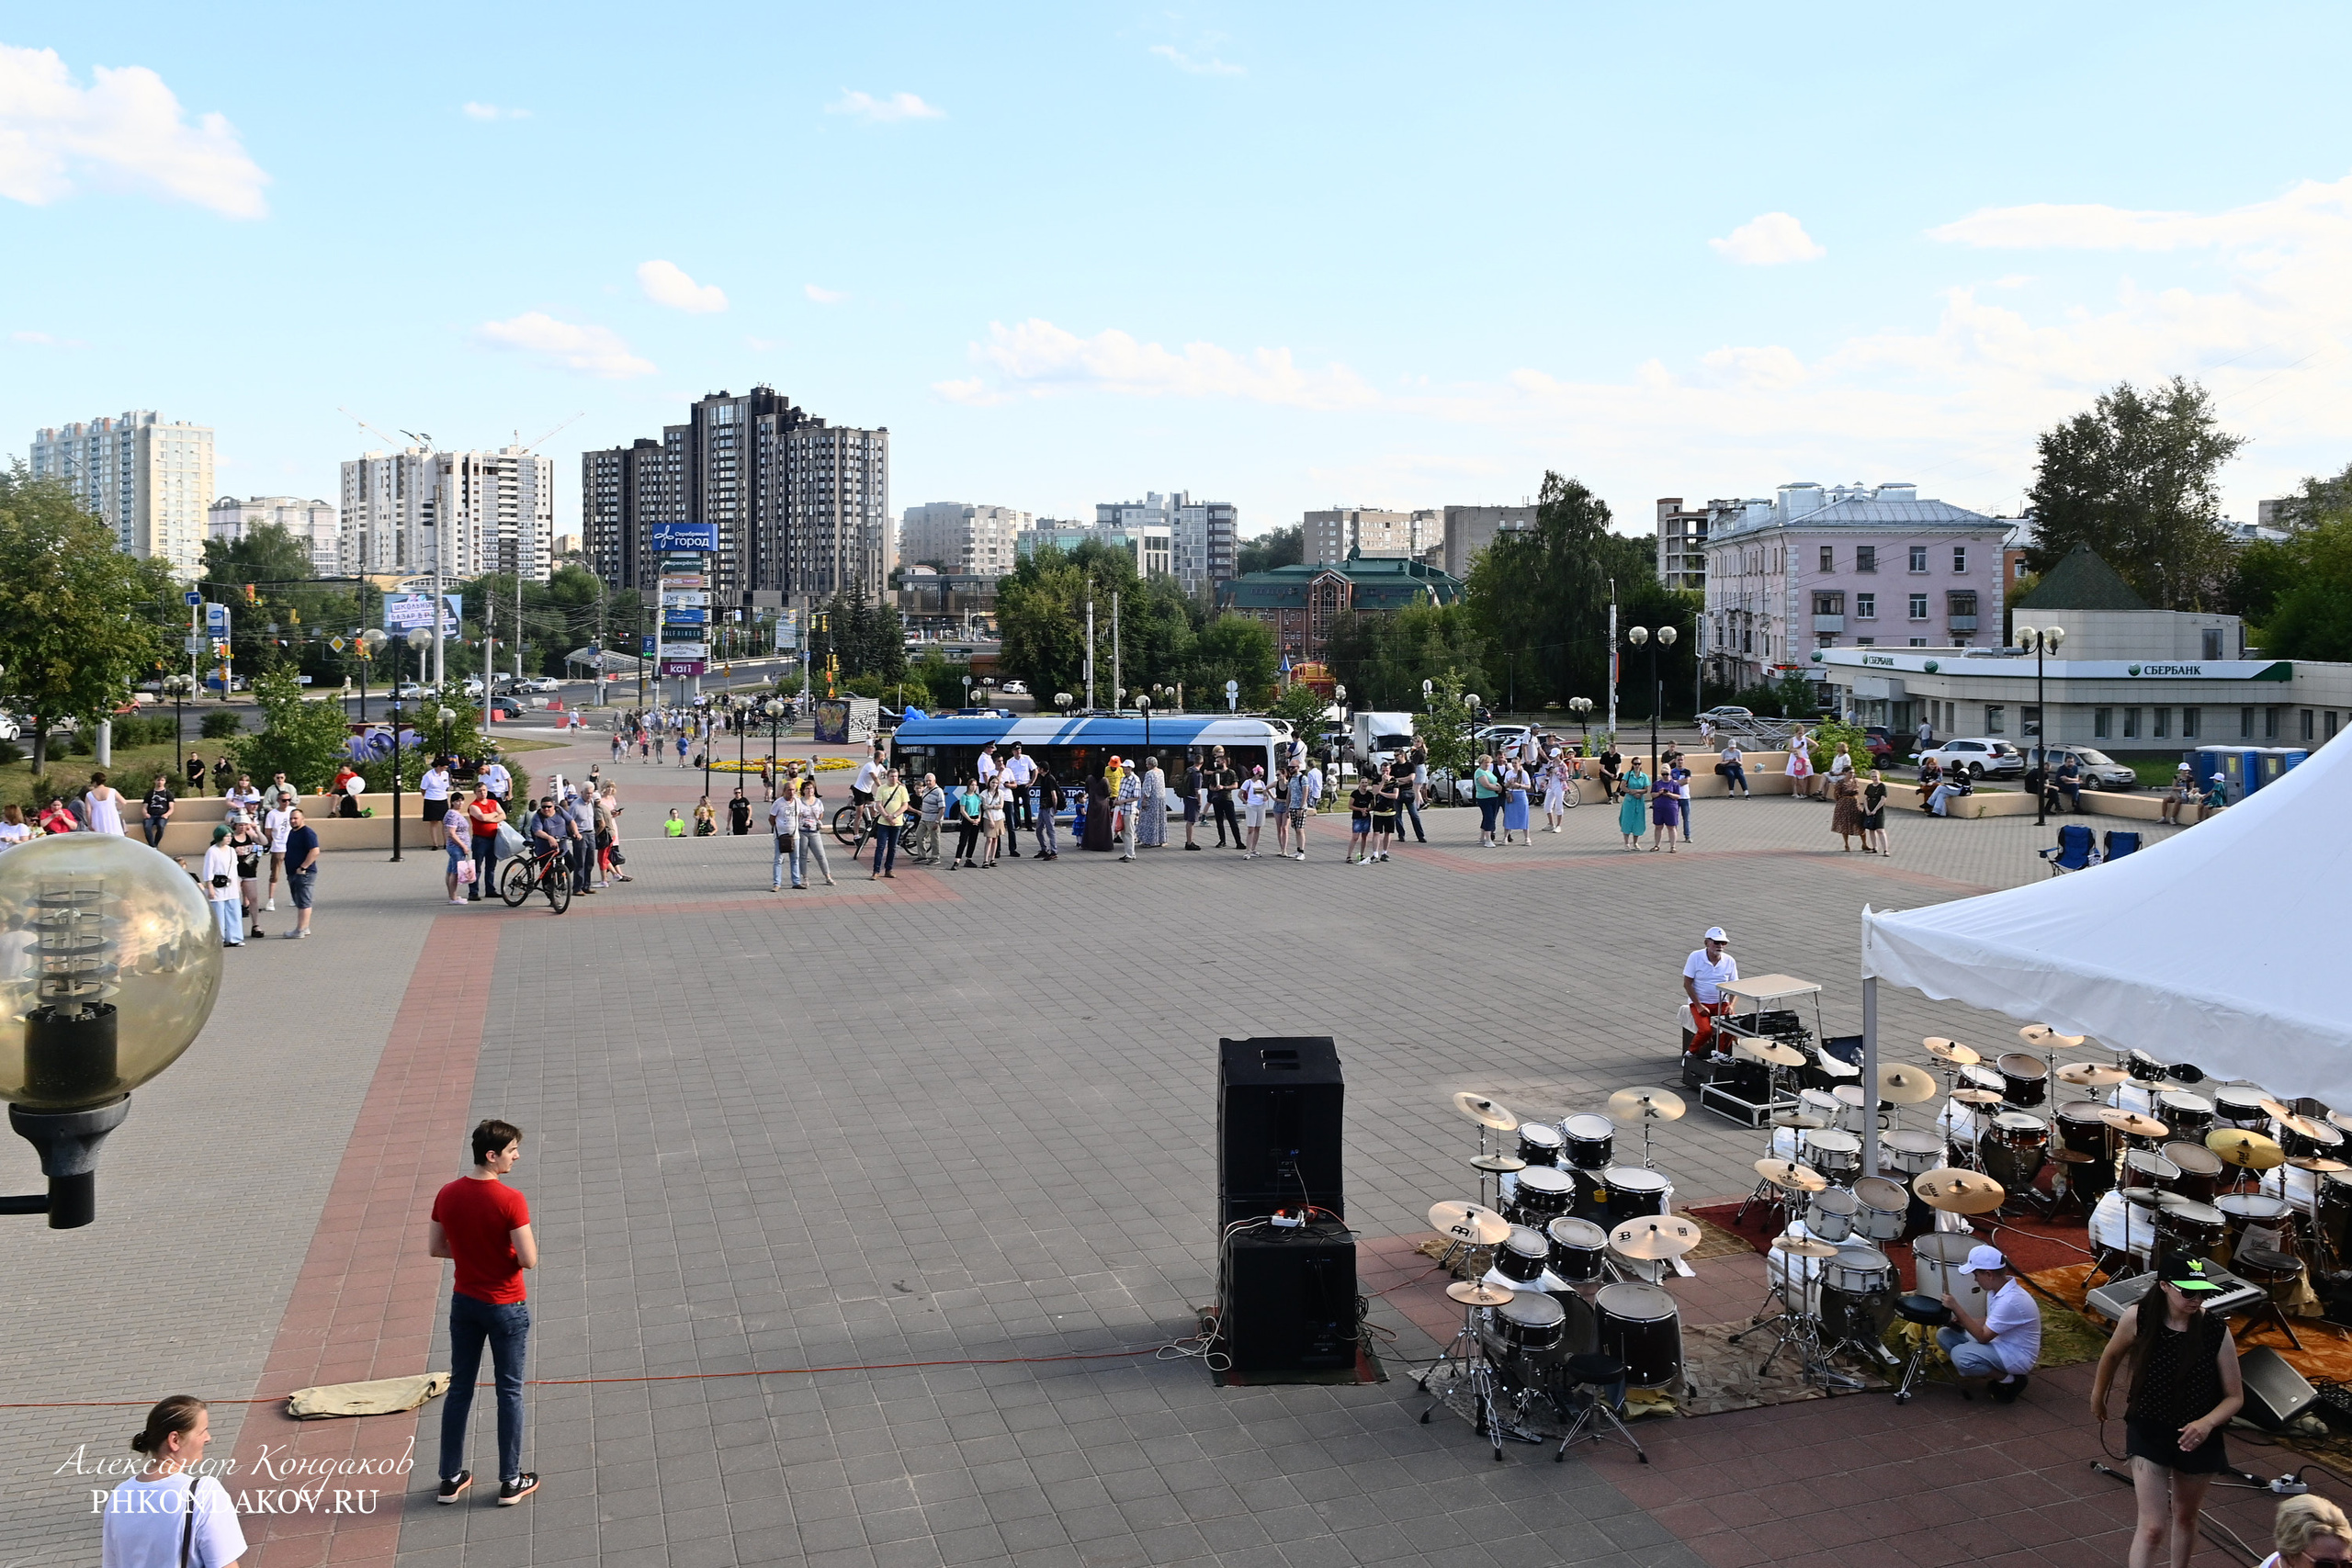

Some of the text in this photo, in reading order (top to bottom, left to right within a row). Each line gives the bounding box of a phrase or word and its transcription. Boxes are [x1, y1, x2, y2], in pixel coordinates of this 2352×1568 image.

[674, 538, 710, 548] город
[390, 612, 415, 620] БАЗАР
[1868, 656, 1894, 666] СБЕРБАНК
[670, 664, 692, 672] kari
[2143, 665, 2201, 675] СБЕРБАНК
